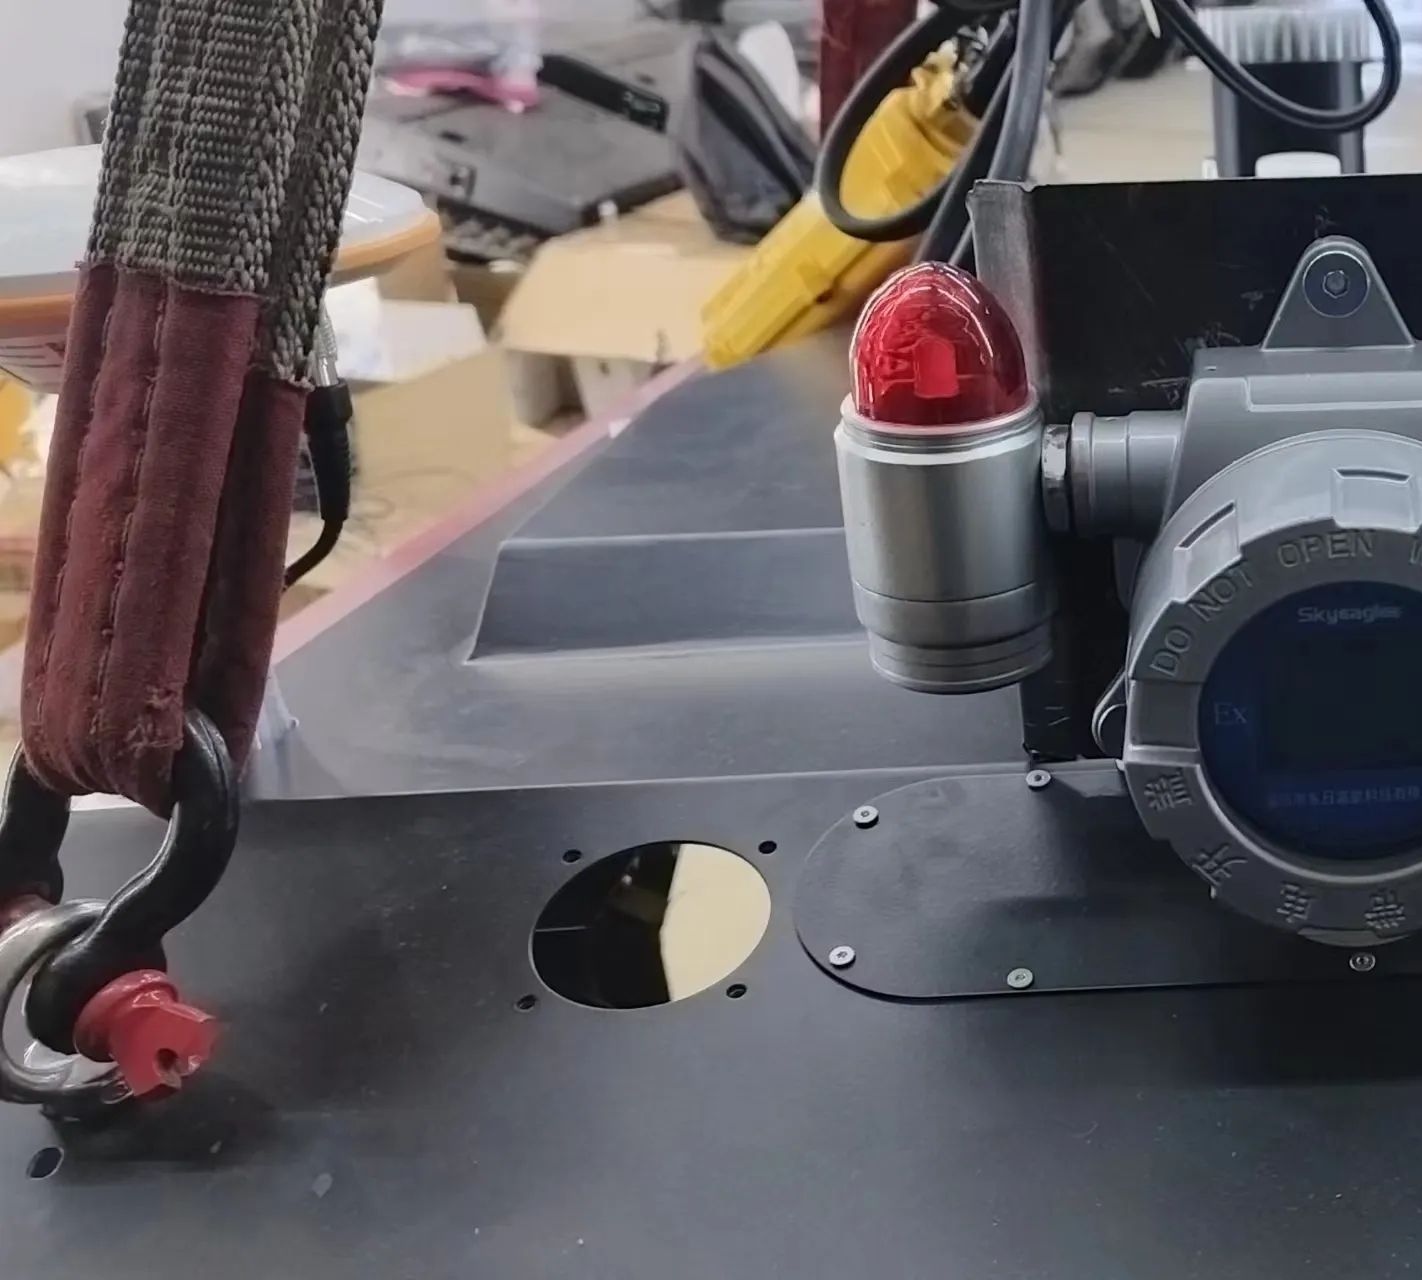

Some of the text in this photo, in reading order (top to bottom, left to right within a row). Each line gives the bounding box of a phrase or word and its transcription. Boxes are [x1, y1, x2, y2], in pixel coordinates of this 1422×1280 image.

[1150, 627, 1191, 679] DO
[1191, 560, 1256, 621] NOT
[1276, 531, 1374, 570] OPEN
[1214, 703, 1248, 726] Ex
